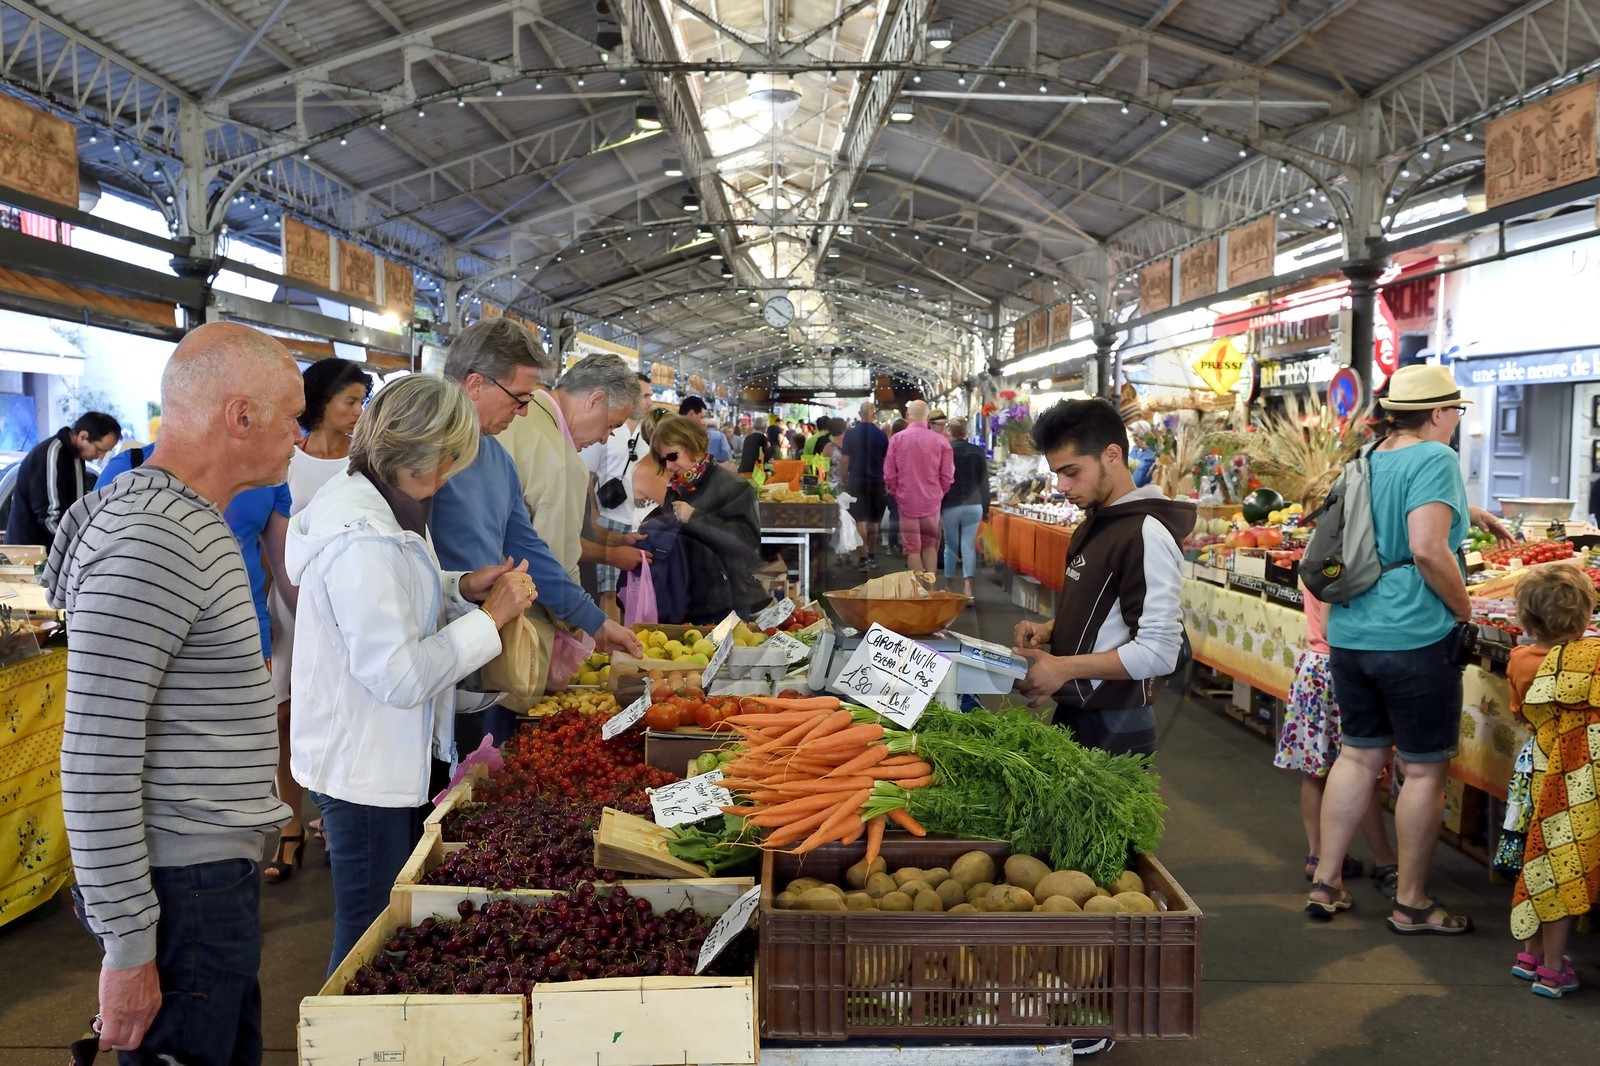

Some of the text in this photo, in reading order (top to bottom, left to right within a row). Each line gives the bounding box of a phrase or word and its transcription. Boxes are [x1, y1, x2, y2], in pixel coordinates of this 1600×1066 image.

[1201, 361, 1243, 370] PRESS
[1261, 365, 1281, 387] BAR
[1472, 369, 1496, 383] une
[1498, 360, 1526, 381] idée
[1527, 363, 1569, 380] neuve
[1570, 353, 1591, 376] de
